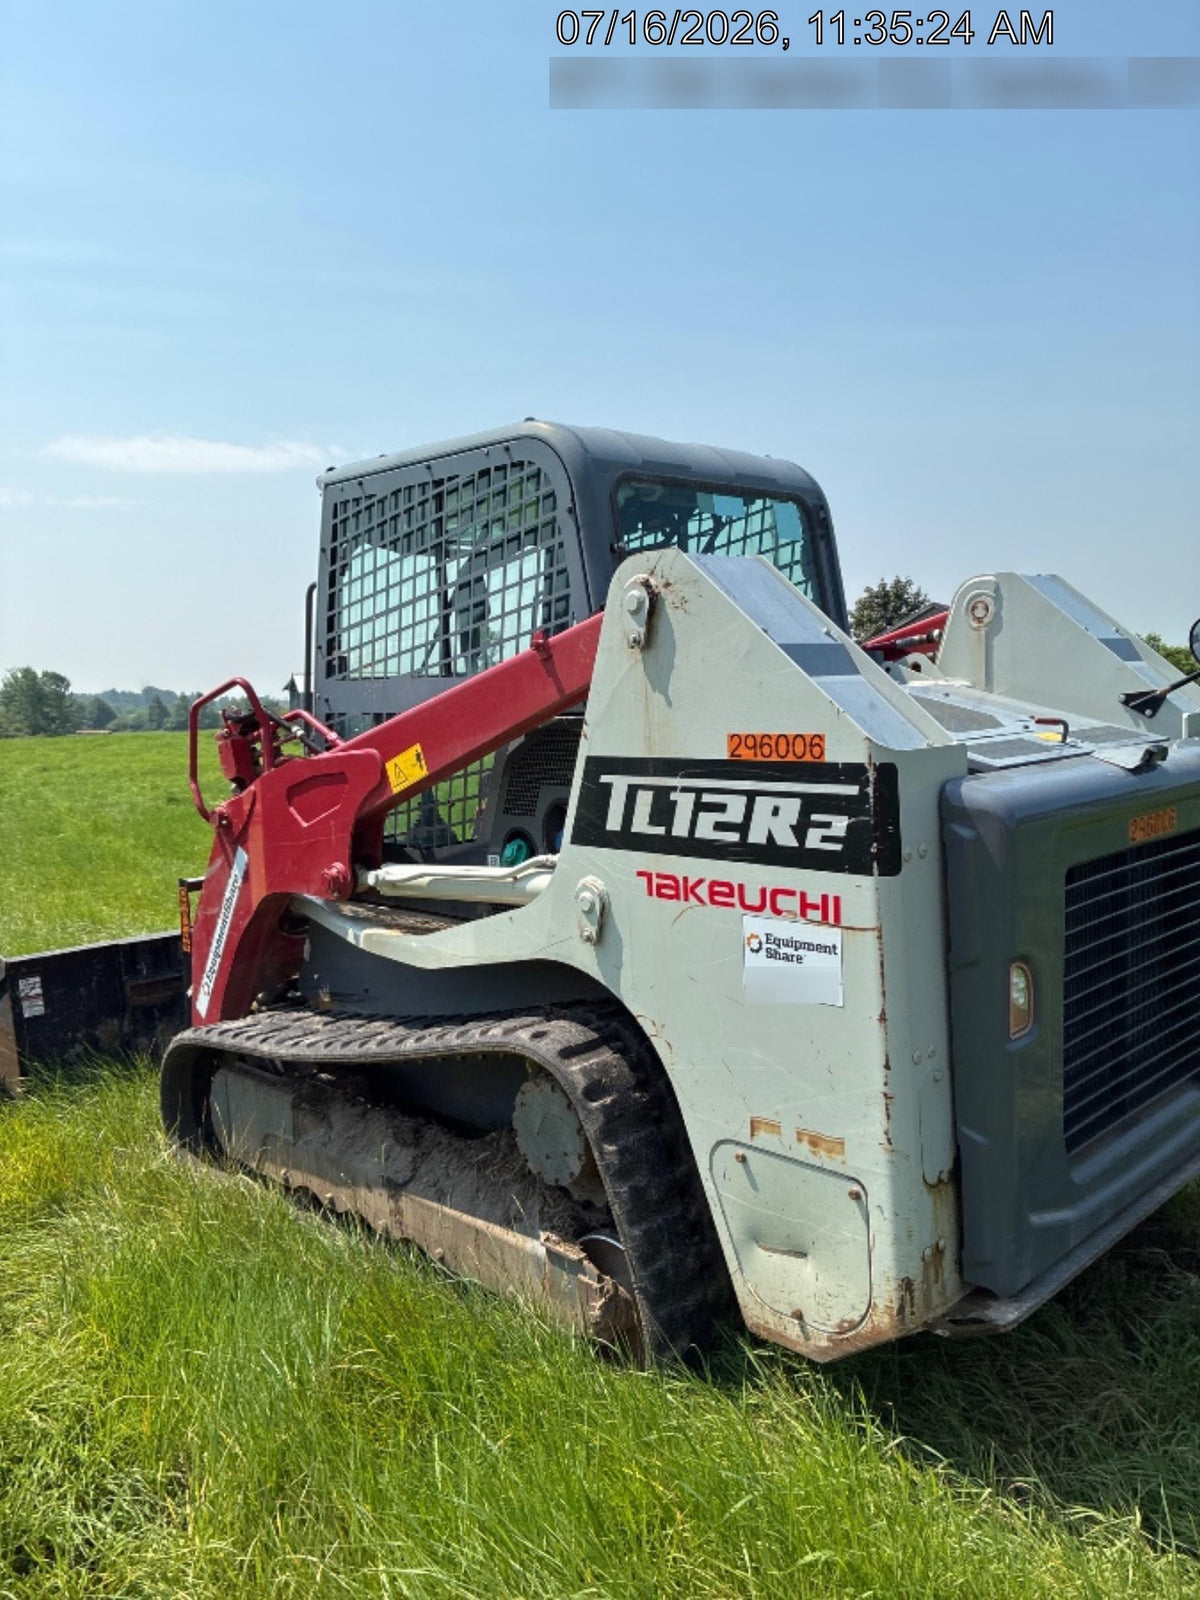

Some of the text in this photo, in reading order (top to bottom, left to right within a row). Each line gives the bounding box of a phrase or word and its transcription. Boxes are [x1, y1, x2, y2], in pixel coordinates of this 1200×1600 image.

[729, 734, 824, 759] 296006
[600, 775, 859, 851] TL12R2
[764, 932, 838, 955] Equipment
[765, 947, 803, 964] Share
